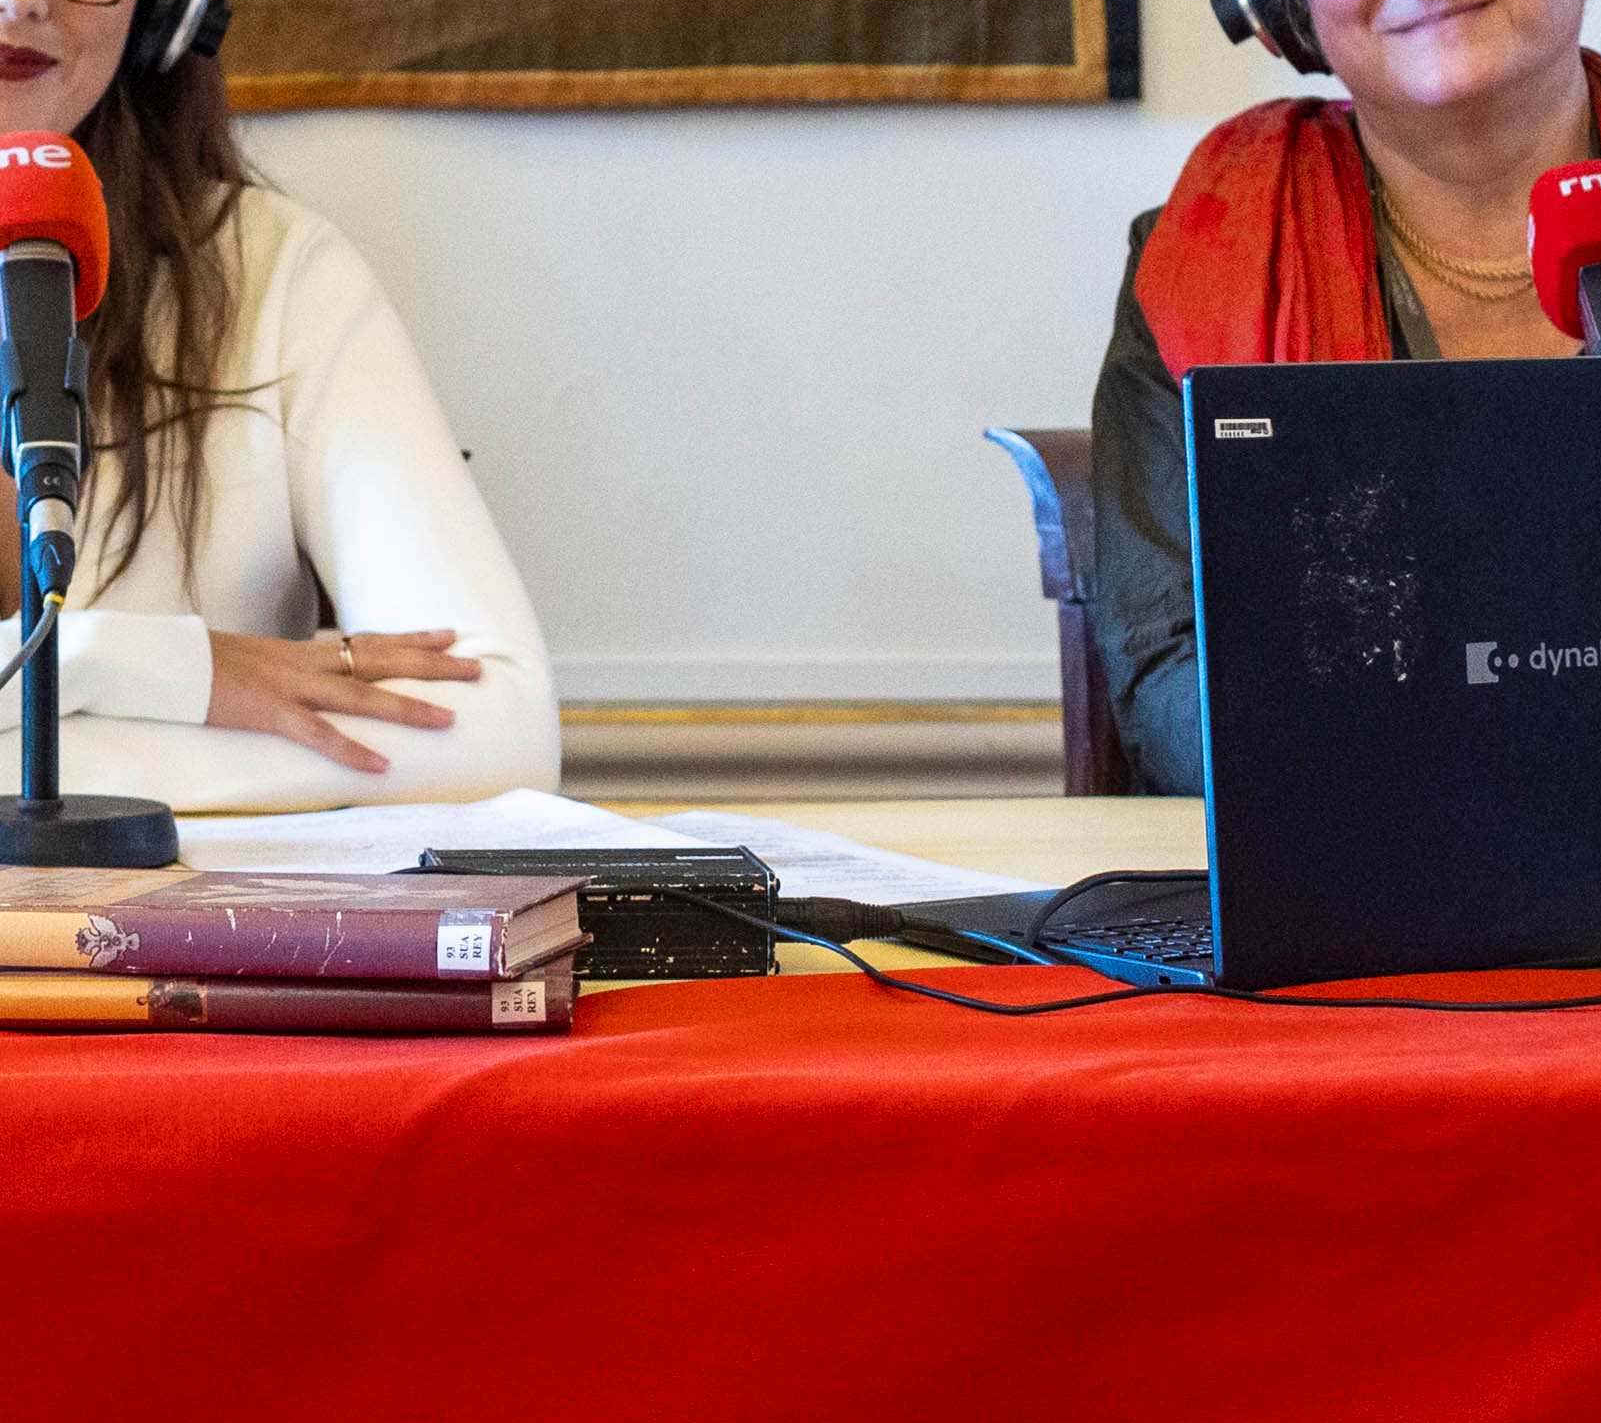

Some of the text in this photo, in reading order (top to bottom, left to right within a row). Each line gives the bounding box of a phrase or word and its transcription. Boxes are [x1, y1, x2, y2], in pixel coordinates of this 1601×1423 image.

[446, 946, 456, 959] 93
[460, 936, 469, 959] SUA
[473, 934, 482, 959] REY
[514, 989, 523, 1012] SUA
[527, 989, 536, 1013] REY
